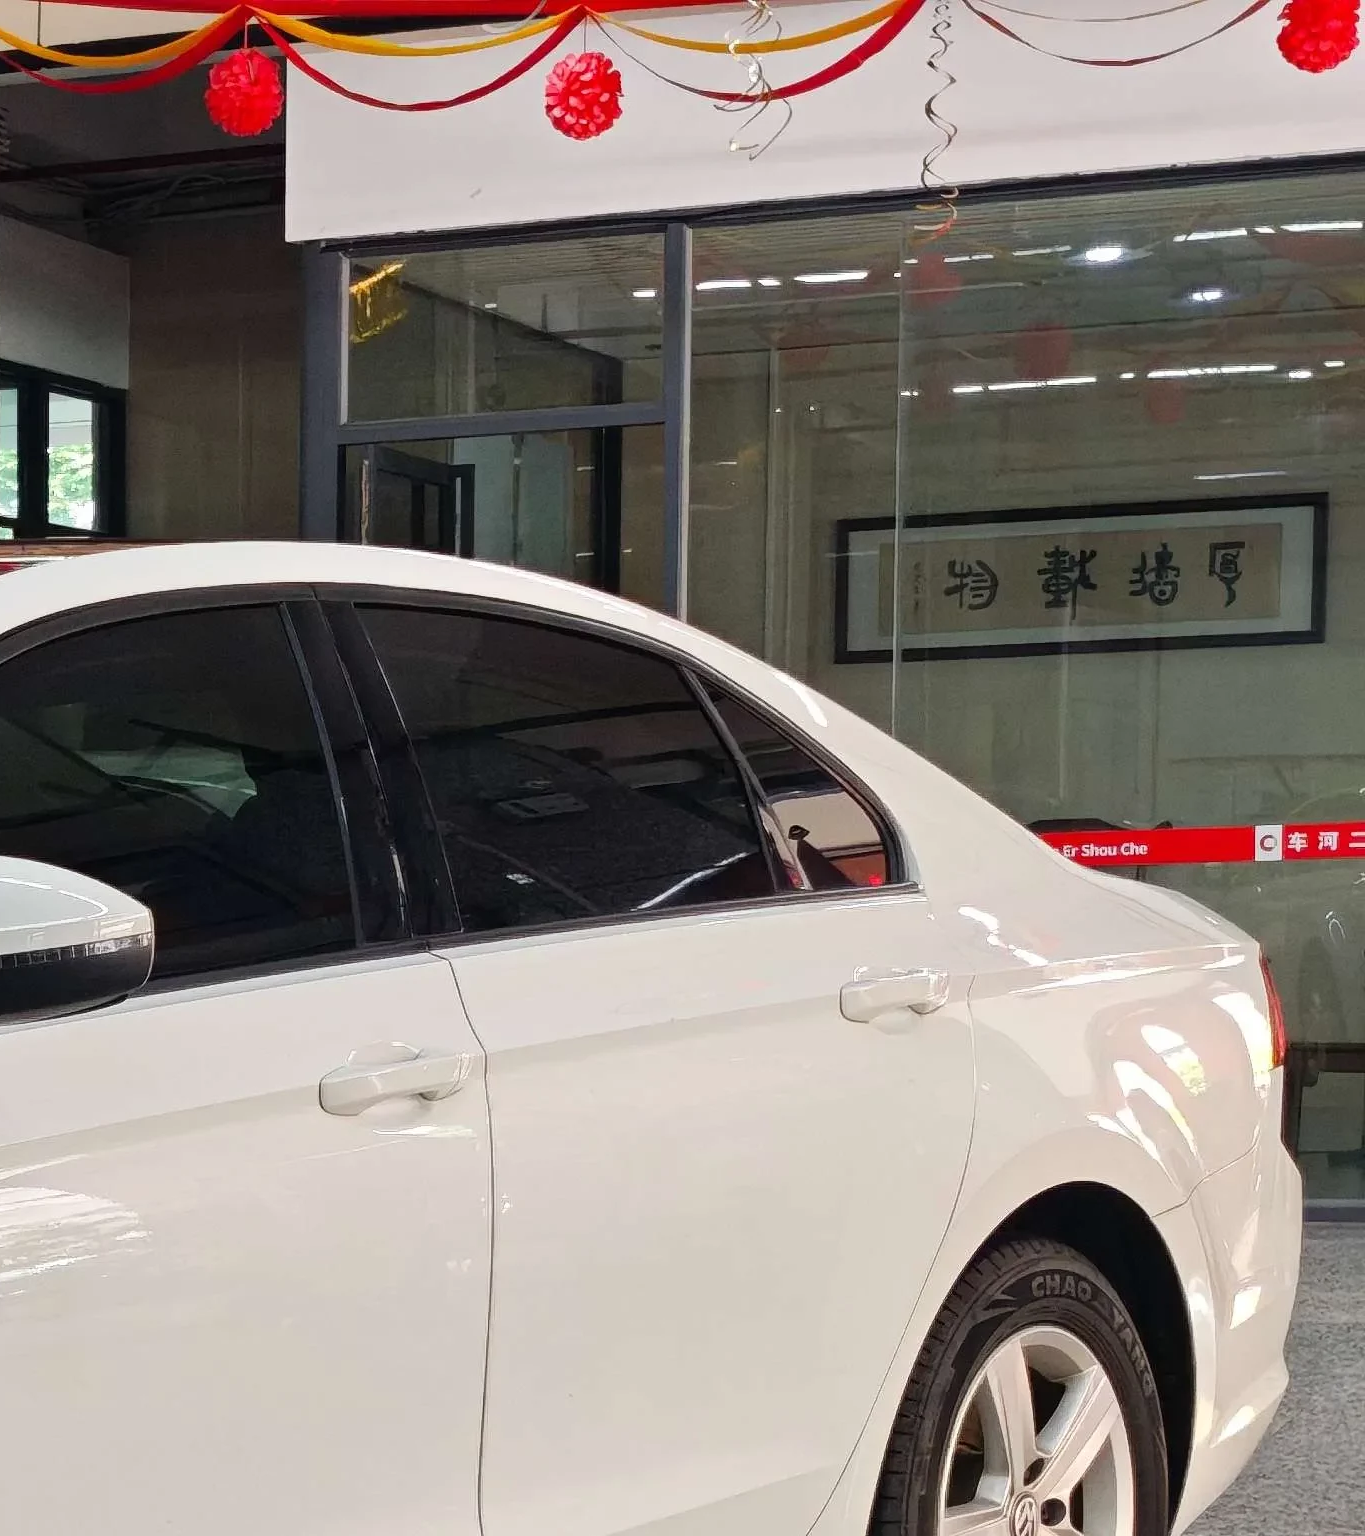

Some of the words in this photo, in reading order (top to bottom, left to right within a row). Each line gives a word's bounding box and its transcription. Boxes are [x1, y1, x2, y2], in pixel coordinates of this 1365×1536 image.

[1063, 844, 1079, 857] Er
[1081, 844, 1118, 857] Shou
[1120, 842, 1149, 856] Che
[1031, 1273, 1092, 1302] CHAO
